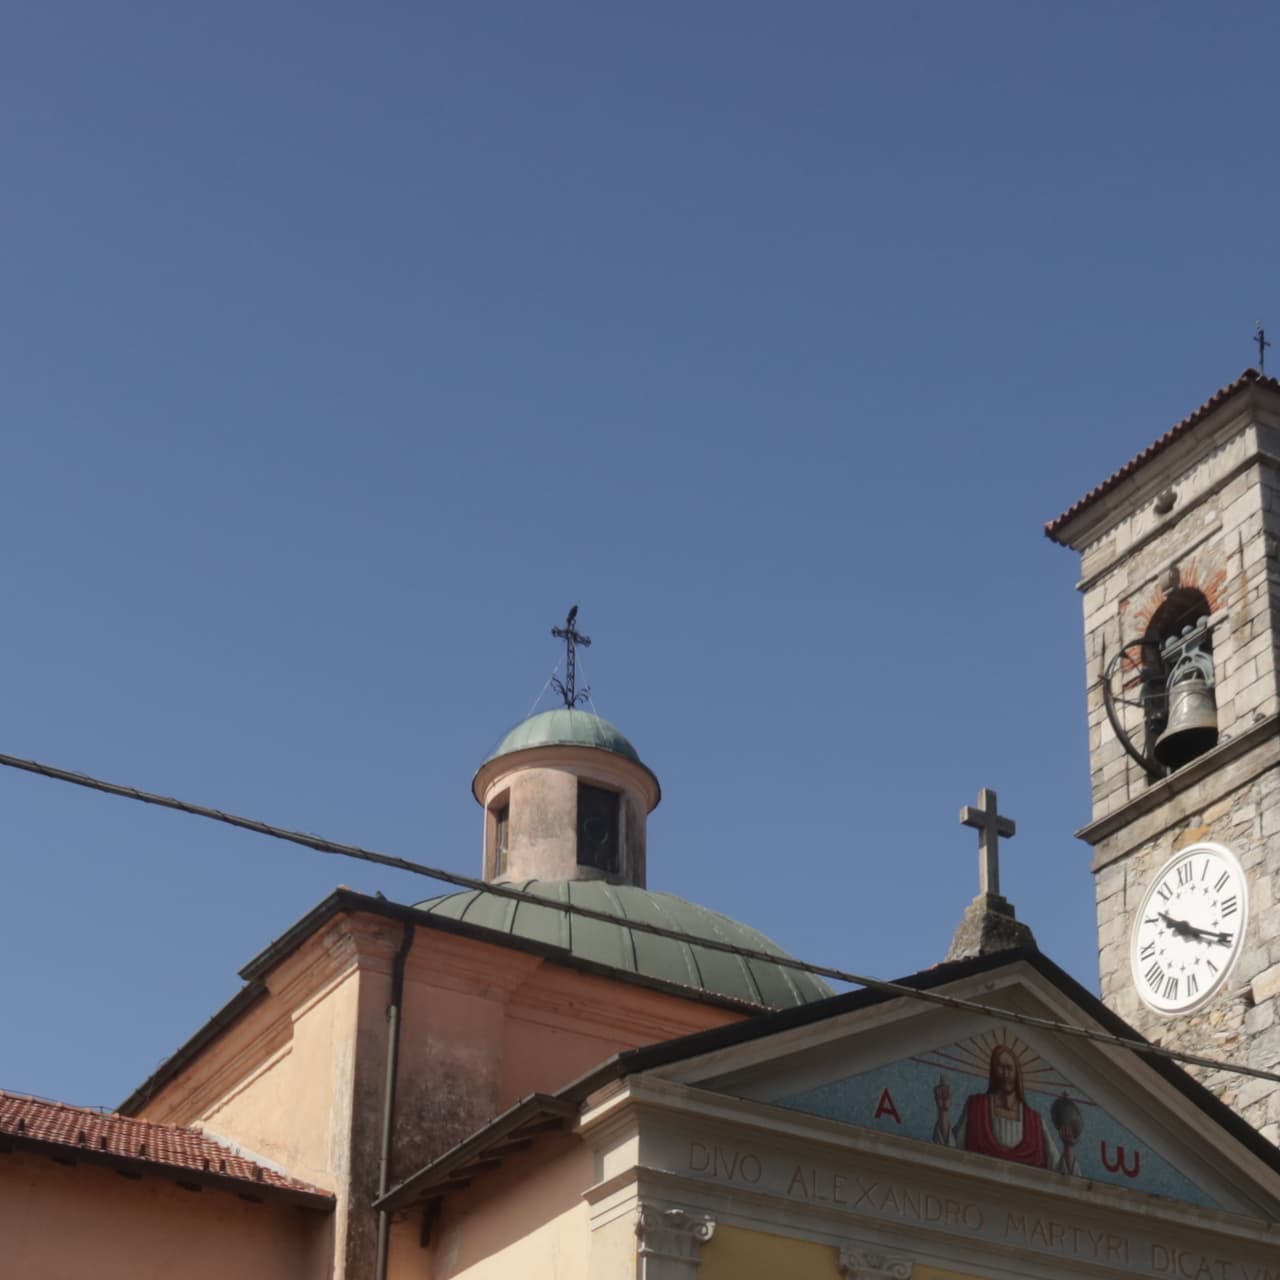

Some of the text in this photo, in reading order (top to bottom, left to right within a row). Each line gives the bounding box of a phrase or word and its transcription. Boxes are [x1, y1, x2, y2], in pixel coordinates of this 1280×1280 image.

[1176, 860, 1193, 887] XII
[1214, 870, 1230, 893] II
[1157, 882, 1173, 901] XI
[1221, 895, 1237, 918] III
[874, 1087, 902, 1125] A
[688, 1141, 763, 1185] DIVO
[786, 1164, 985, 1233] ALEXANDRO
[1004, 1212, 1130, 1265] MARTYRI
